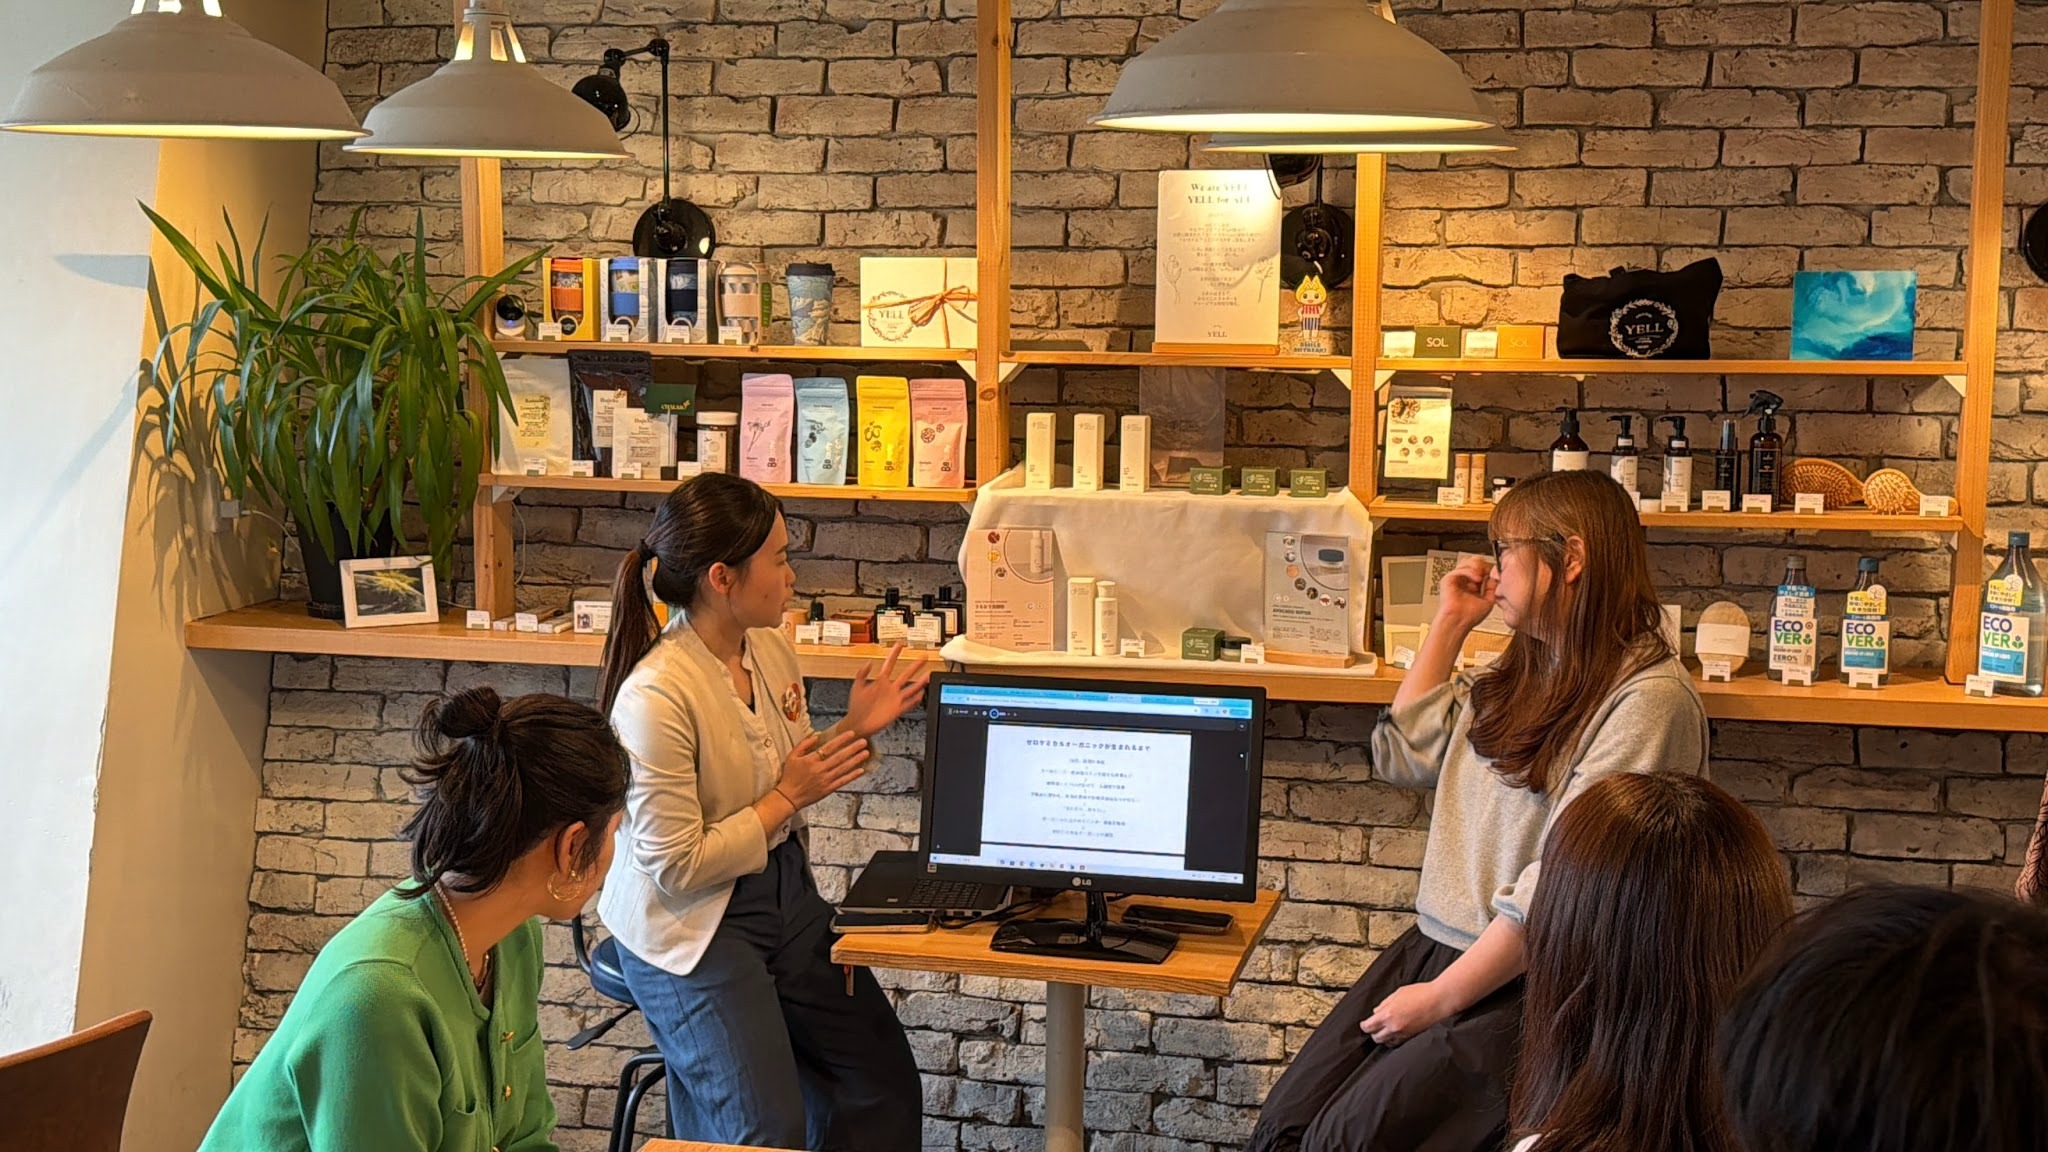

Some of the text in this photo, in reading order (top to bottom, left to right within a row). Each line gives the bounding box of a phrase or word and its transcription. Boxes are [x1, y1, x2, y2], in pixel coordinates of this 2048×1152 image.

[1187, 196, 1212, 204] YELL
[1624, 323, 1664, 335] YELL
[1774, 619, 1804, 633] ECO
[1846, 622, 1876, 636] ECO
[1984, 616, 2012, 633] ECO
[1774, 632, 1802, 645] VER
[1846, 635, 1874, 648] VER
[1984, 632, 2010, 648] VER
[1773, 654, 1798, 662] ZERO%
